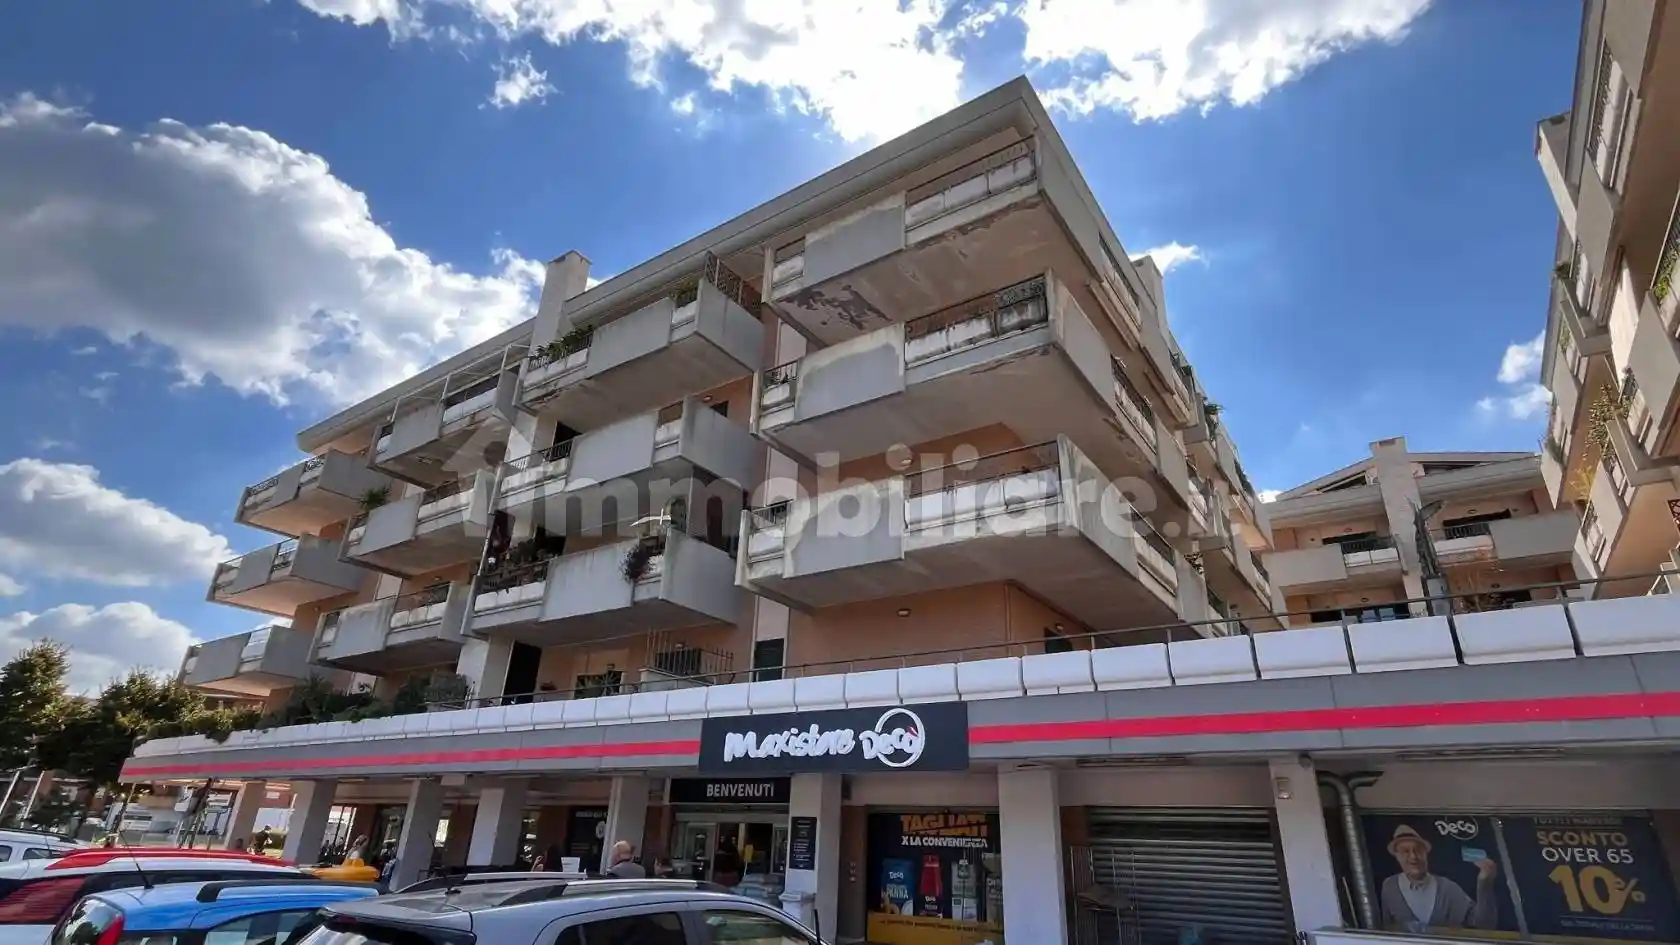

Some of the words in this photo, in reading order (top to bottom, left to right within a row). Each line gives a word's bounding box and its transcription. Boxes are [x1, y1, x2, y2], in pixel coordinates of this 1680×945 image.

[723, 723, 855, 763] Maxistore
[706, 783, 775, 797] BENVENUTI
[901, 835, 909, 846] X
[910, 836, 922, 846] LA
[1536, 831, 1628, 846] SCONTO
[1542, 847, 1602, 863] OVER
[1606, 848, 1634, 864] 65
[1548, 865, 1646, 914] 10%
